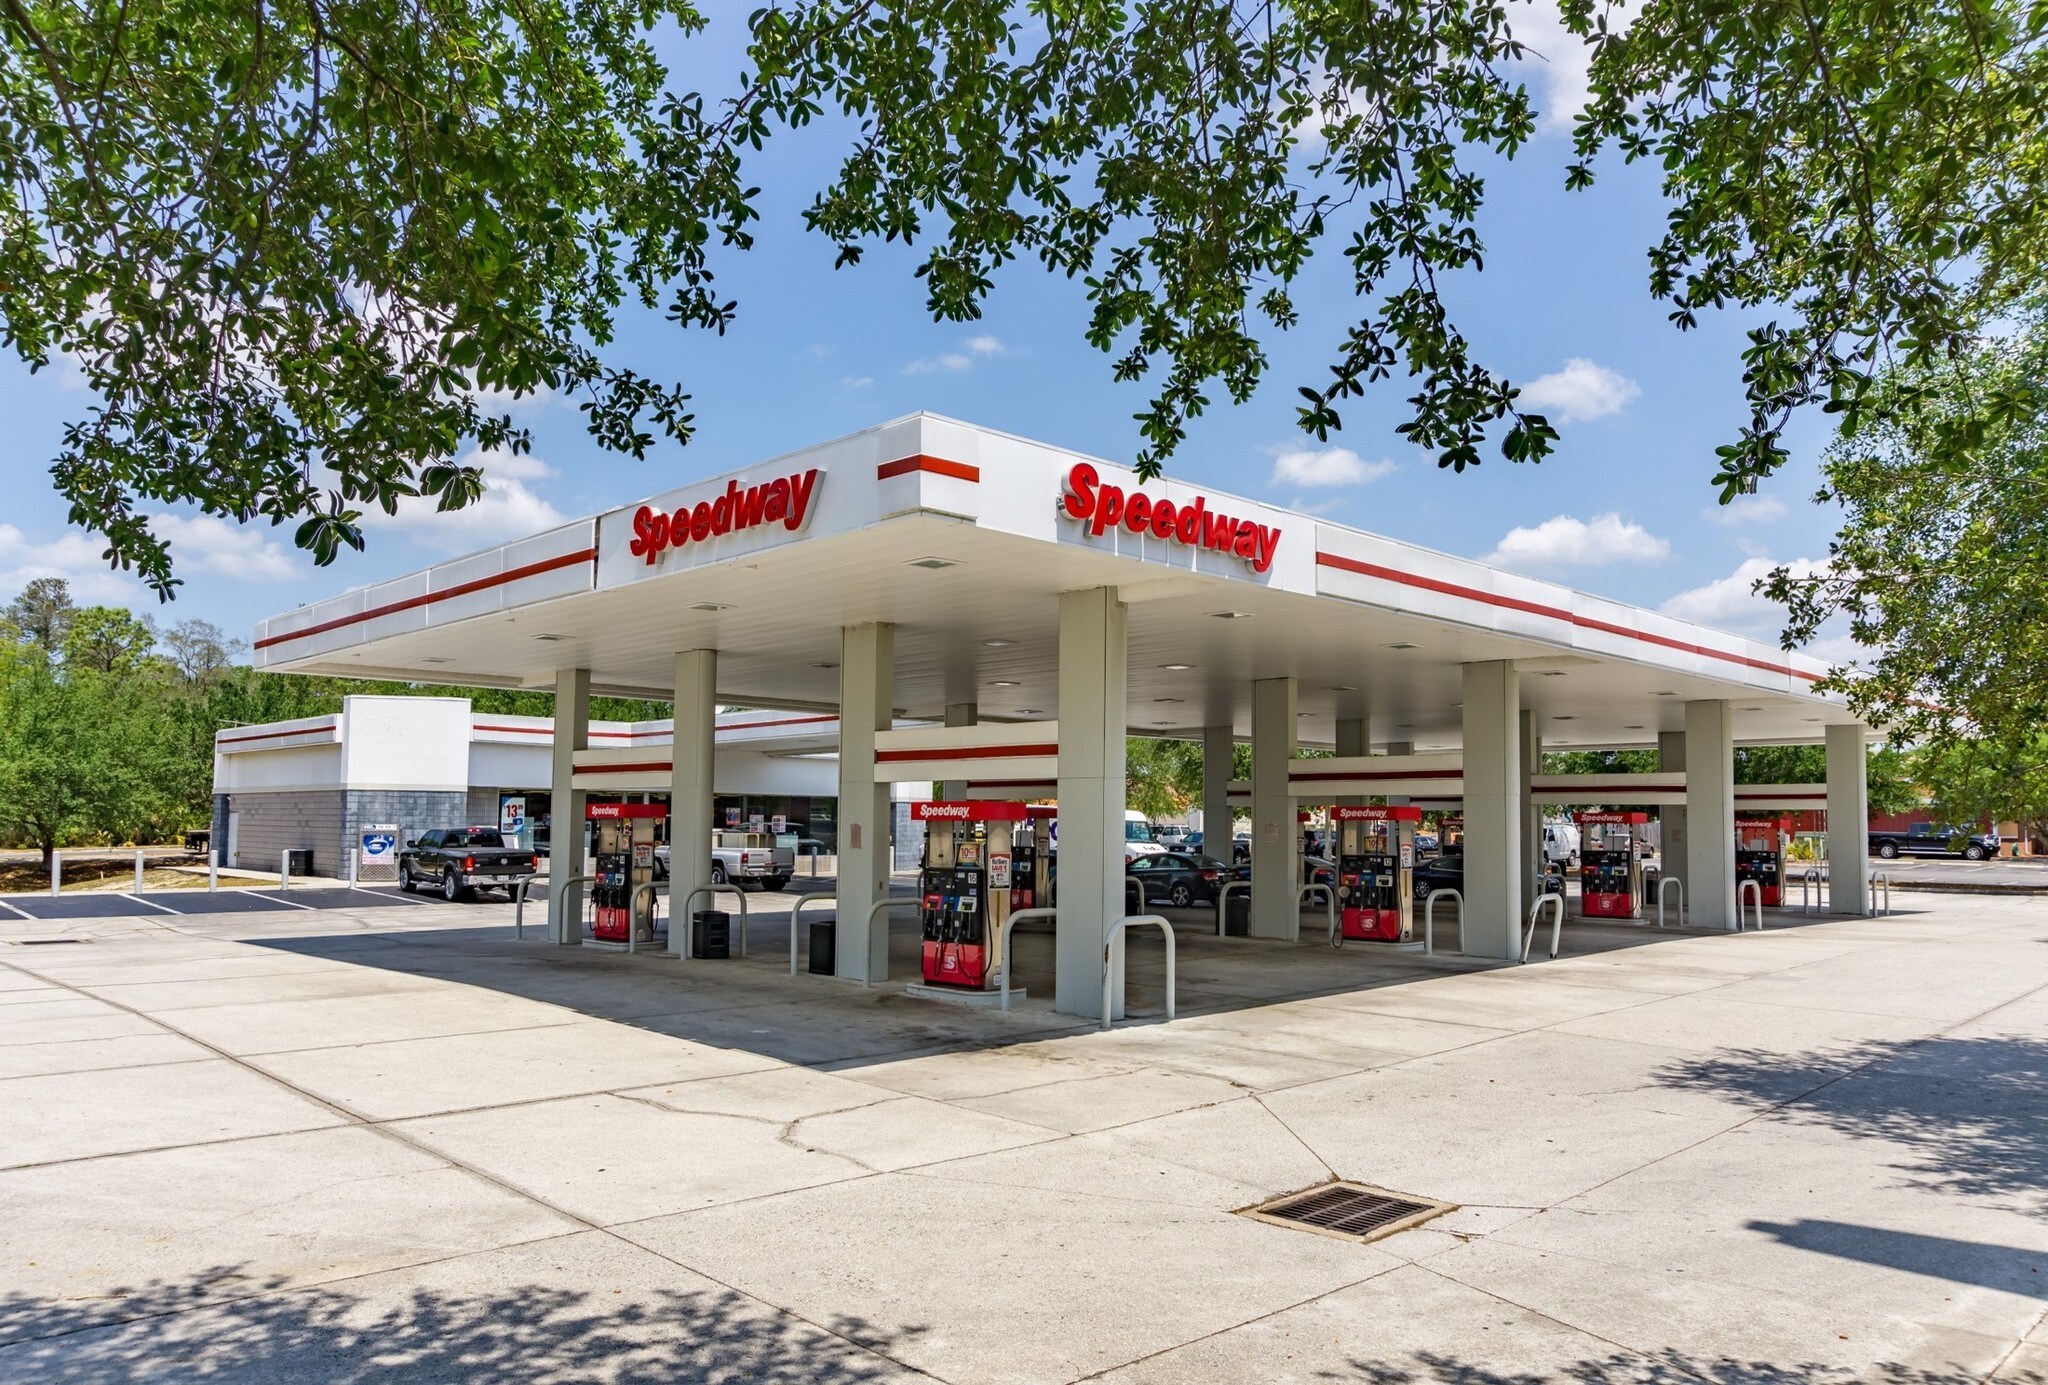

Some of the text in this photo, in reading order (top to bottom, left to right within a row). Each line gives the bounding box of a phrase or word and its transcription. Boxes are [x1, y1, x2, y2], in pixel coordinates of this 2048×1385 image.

[630, 469, 818, 566] Speedway
[1064, 463, 1282, 573] Speedway
[591, 805, 619, 816] Speedway
[920, 804, 970, 818] Speedway
[1340, 808, 1387, 819] Speedway
[1581, 814, 1624, 822] Speedway
[1735, 820, 1773, 829] Speedway
